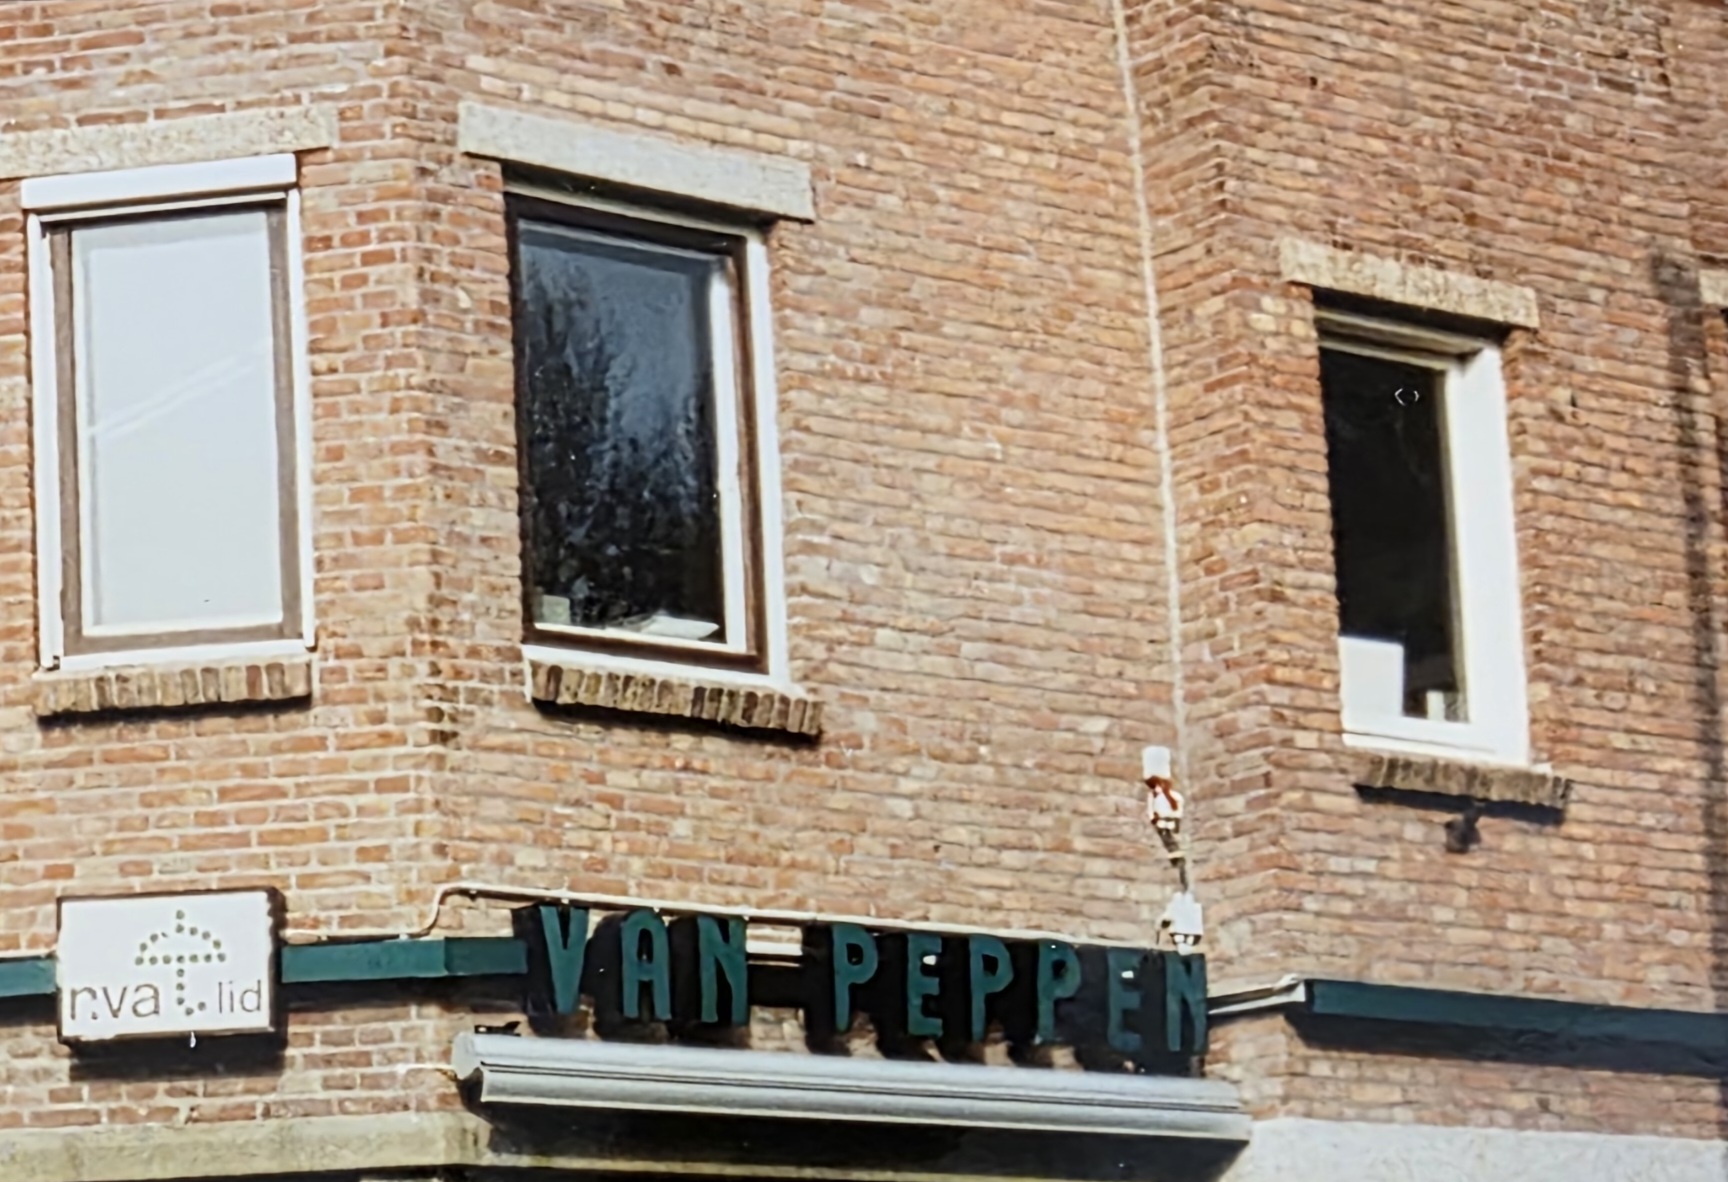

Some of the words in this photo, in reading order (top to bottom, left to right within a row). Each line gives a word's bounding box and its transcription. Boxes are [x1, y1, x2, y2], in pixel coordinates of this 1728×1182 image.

[218, 979, 262, 1014] lid
[540, 904, 748, 1027] VAN
[829, 921, 1209, 1055] PEPPEN
